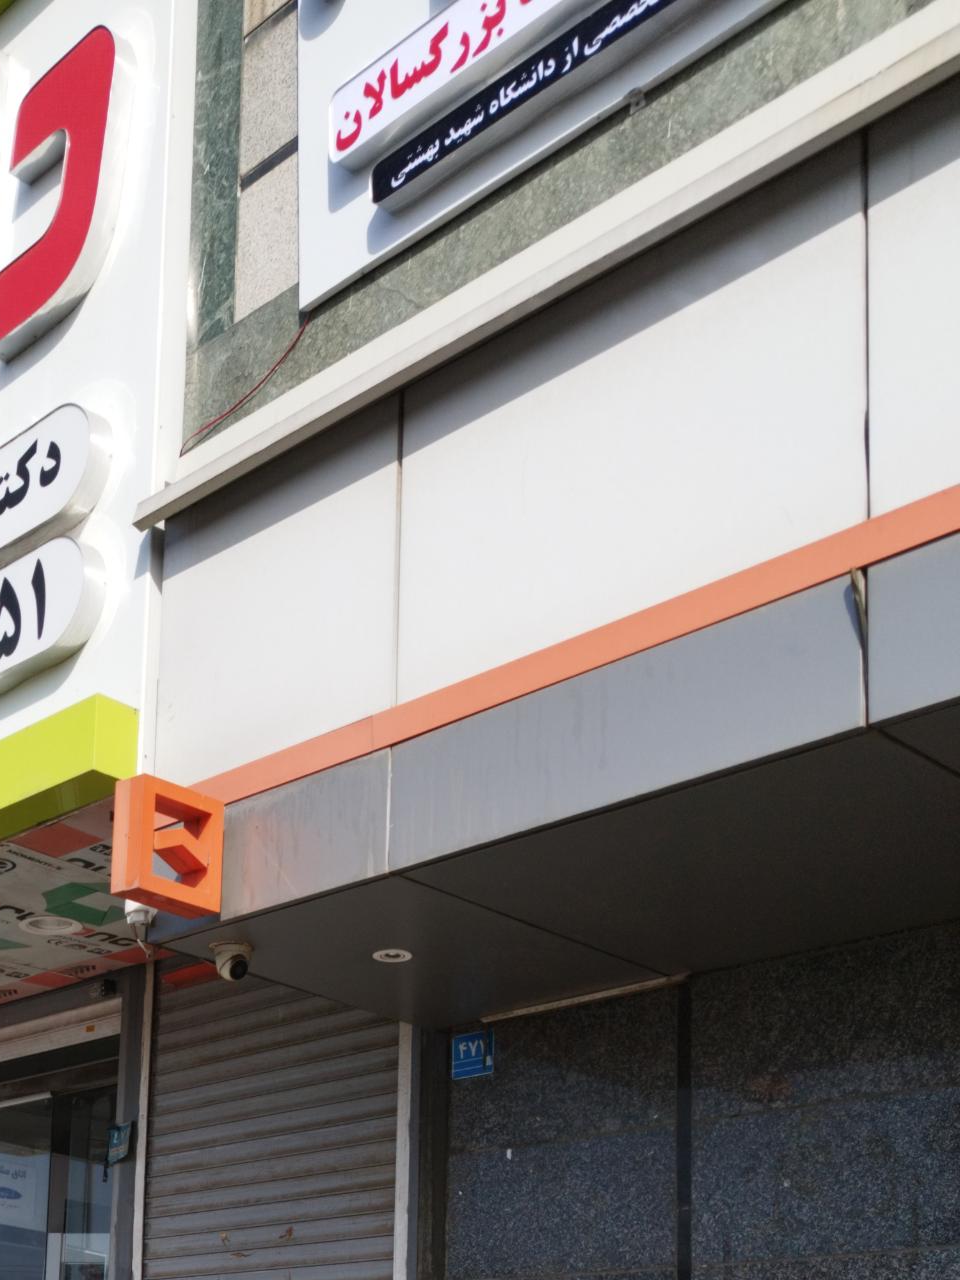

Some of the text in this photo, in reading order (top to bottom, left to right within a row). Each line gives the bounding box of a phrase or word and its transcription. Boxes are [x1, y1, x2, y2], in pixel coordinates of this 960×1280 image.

[562, 36, 580, 73] از
[489, 57, 556, 115] دانشگاه
[444, 104, 484, 146] شهید
[390, 135, 441, 188] بهشتی
